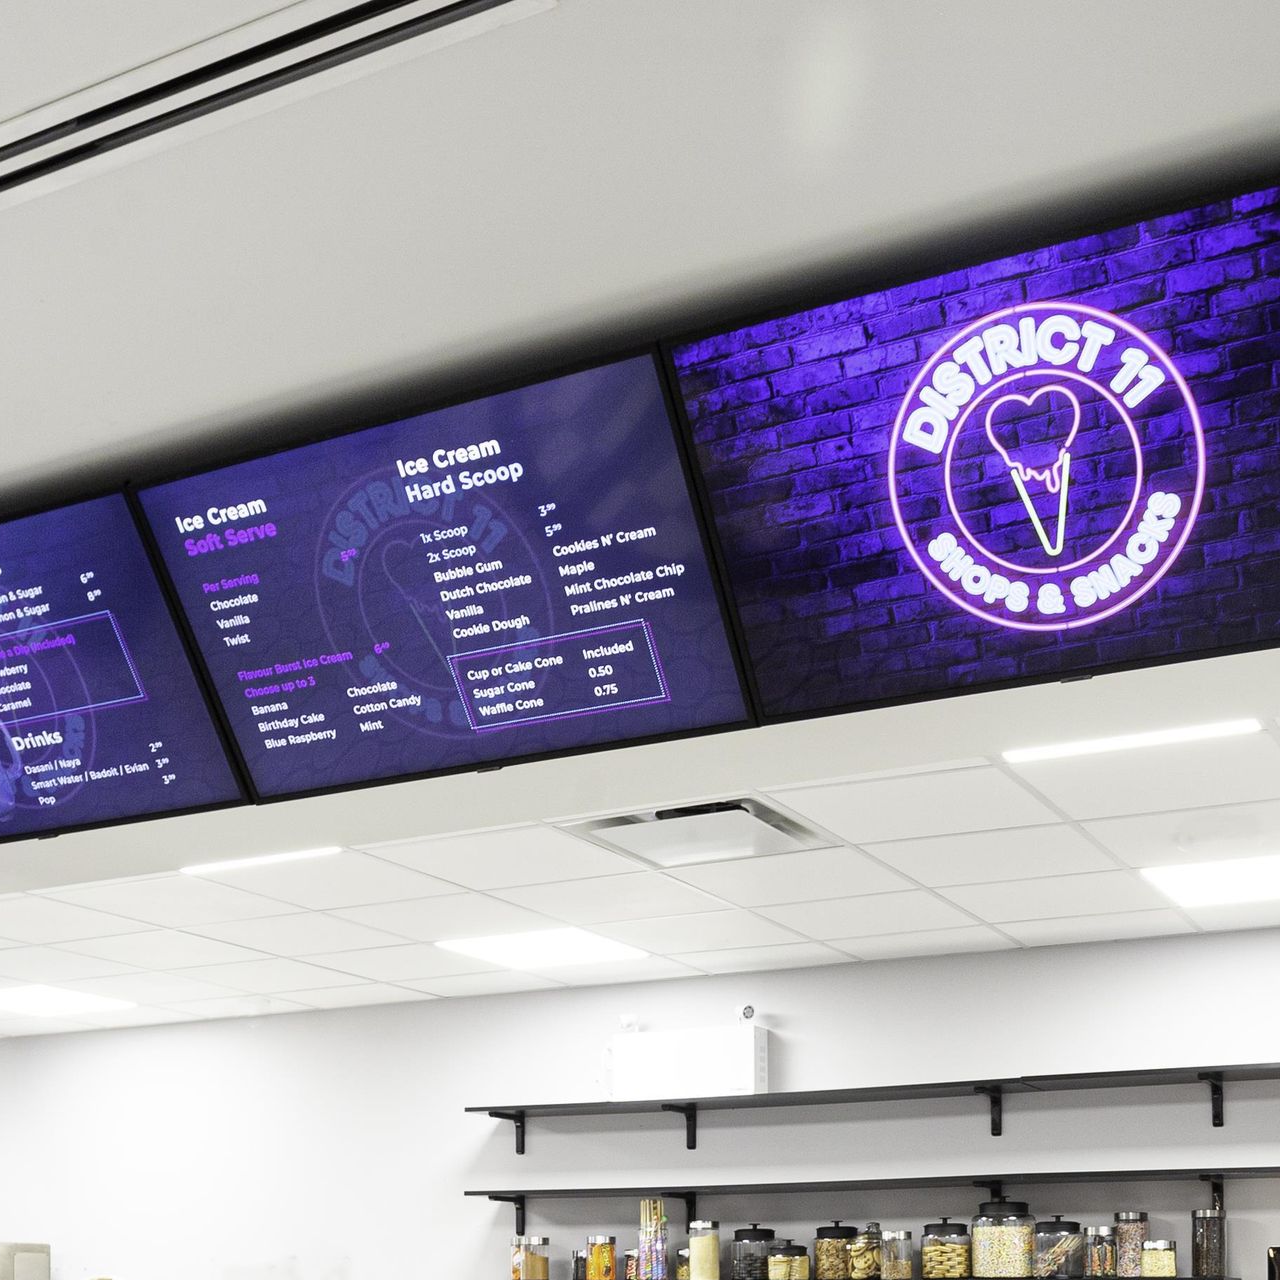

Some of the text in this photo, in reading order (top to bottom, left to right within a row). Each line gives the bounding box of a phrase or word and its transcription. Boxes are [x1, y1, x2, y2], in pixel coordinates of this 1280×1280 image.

[901, 314, 1166, 455] DISTRICT 11
[395, 438, 502, 479] Ice Cream
[404, 461, 524, 503] Hard Scoop
[175, 498, 268, 534] Ice Cream
[184, 522, 278, 557] Soft Serve
[420, 525, 469, 544] 1x Scoop
[552, 538, 600, 557] Cookies
[616, 526, 657, 543] Cream
[426, 545, 477, 564] 2x Scoop
[927, 491, 1182, 615] SHOPS & SNACKS
[433, 560, 504, 583] Bubble Gum
[558, 560, 595, 577] Maple
[202, 573, 260, 594] Per Serving
[440, 574, 532, 602] Dutch Chocolate
[564, 562, 685, 597] Mint Chocolate Chip
[8, 591, 17, 602] &
[15, 585, 43, 599] Sugar
[210, 593, 259, 612] Chocolate
[570, 597, 619, 616] Pralines
[634, 587, 675, 603] Cream
[15, 608, 24, 618] &
[23, 603, 51, 617] Sugar
[445, 604, 484, 621] Vanilla
[216, 614, 251, 629] Vanilla
[452, 614, 531, 639] Cookie Dough
[223, 633, 251, 647] Twist
[583, 640, 634, 660] Included
[237, 651, 353, 682] Flavour Burst Ice Cream
[466, 655, 564, 682] Cup or Cake Cone
[588, 664, 613, 679] 0.50
[244, 683, 281, 699] Choose
[281, 682, 296, 693] up
[295, 678, 306, 689] to
[346, 680, 398, 698] Chocolate
[473, 679, 536, 700] Sugar Cone
[594, 683, 619, 697] 0.75
[251, 701, 289, 716] Banana
[353, 694, 422, 715] Cotton Candy
[479, 697, 544, 717] Waffle Cone
[258, 712, 326, 733] Birthday Cake
[359, 719, 384, 733] Mint
[11, 730, 64, 751] Drinks
[264, 728, 337, 750] Blue Raspberry
[24, 758, 82, 775] Dasani Naya
[30, 762, 150, 791] Smart Water Badoit Evian
[38, 796, 57, 806] Pop
